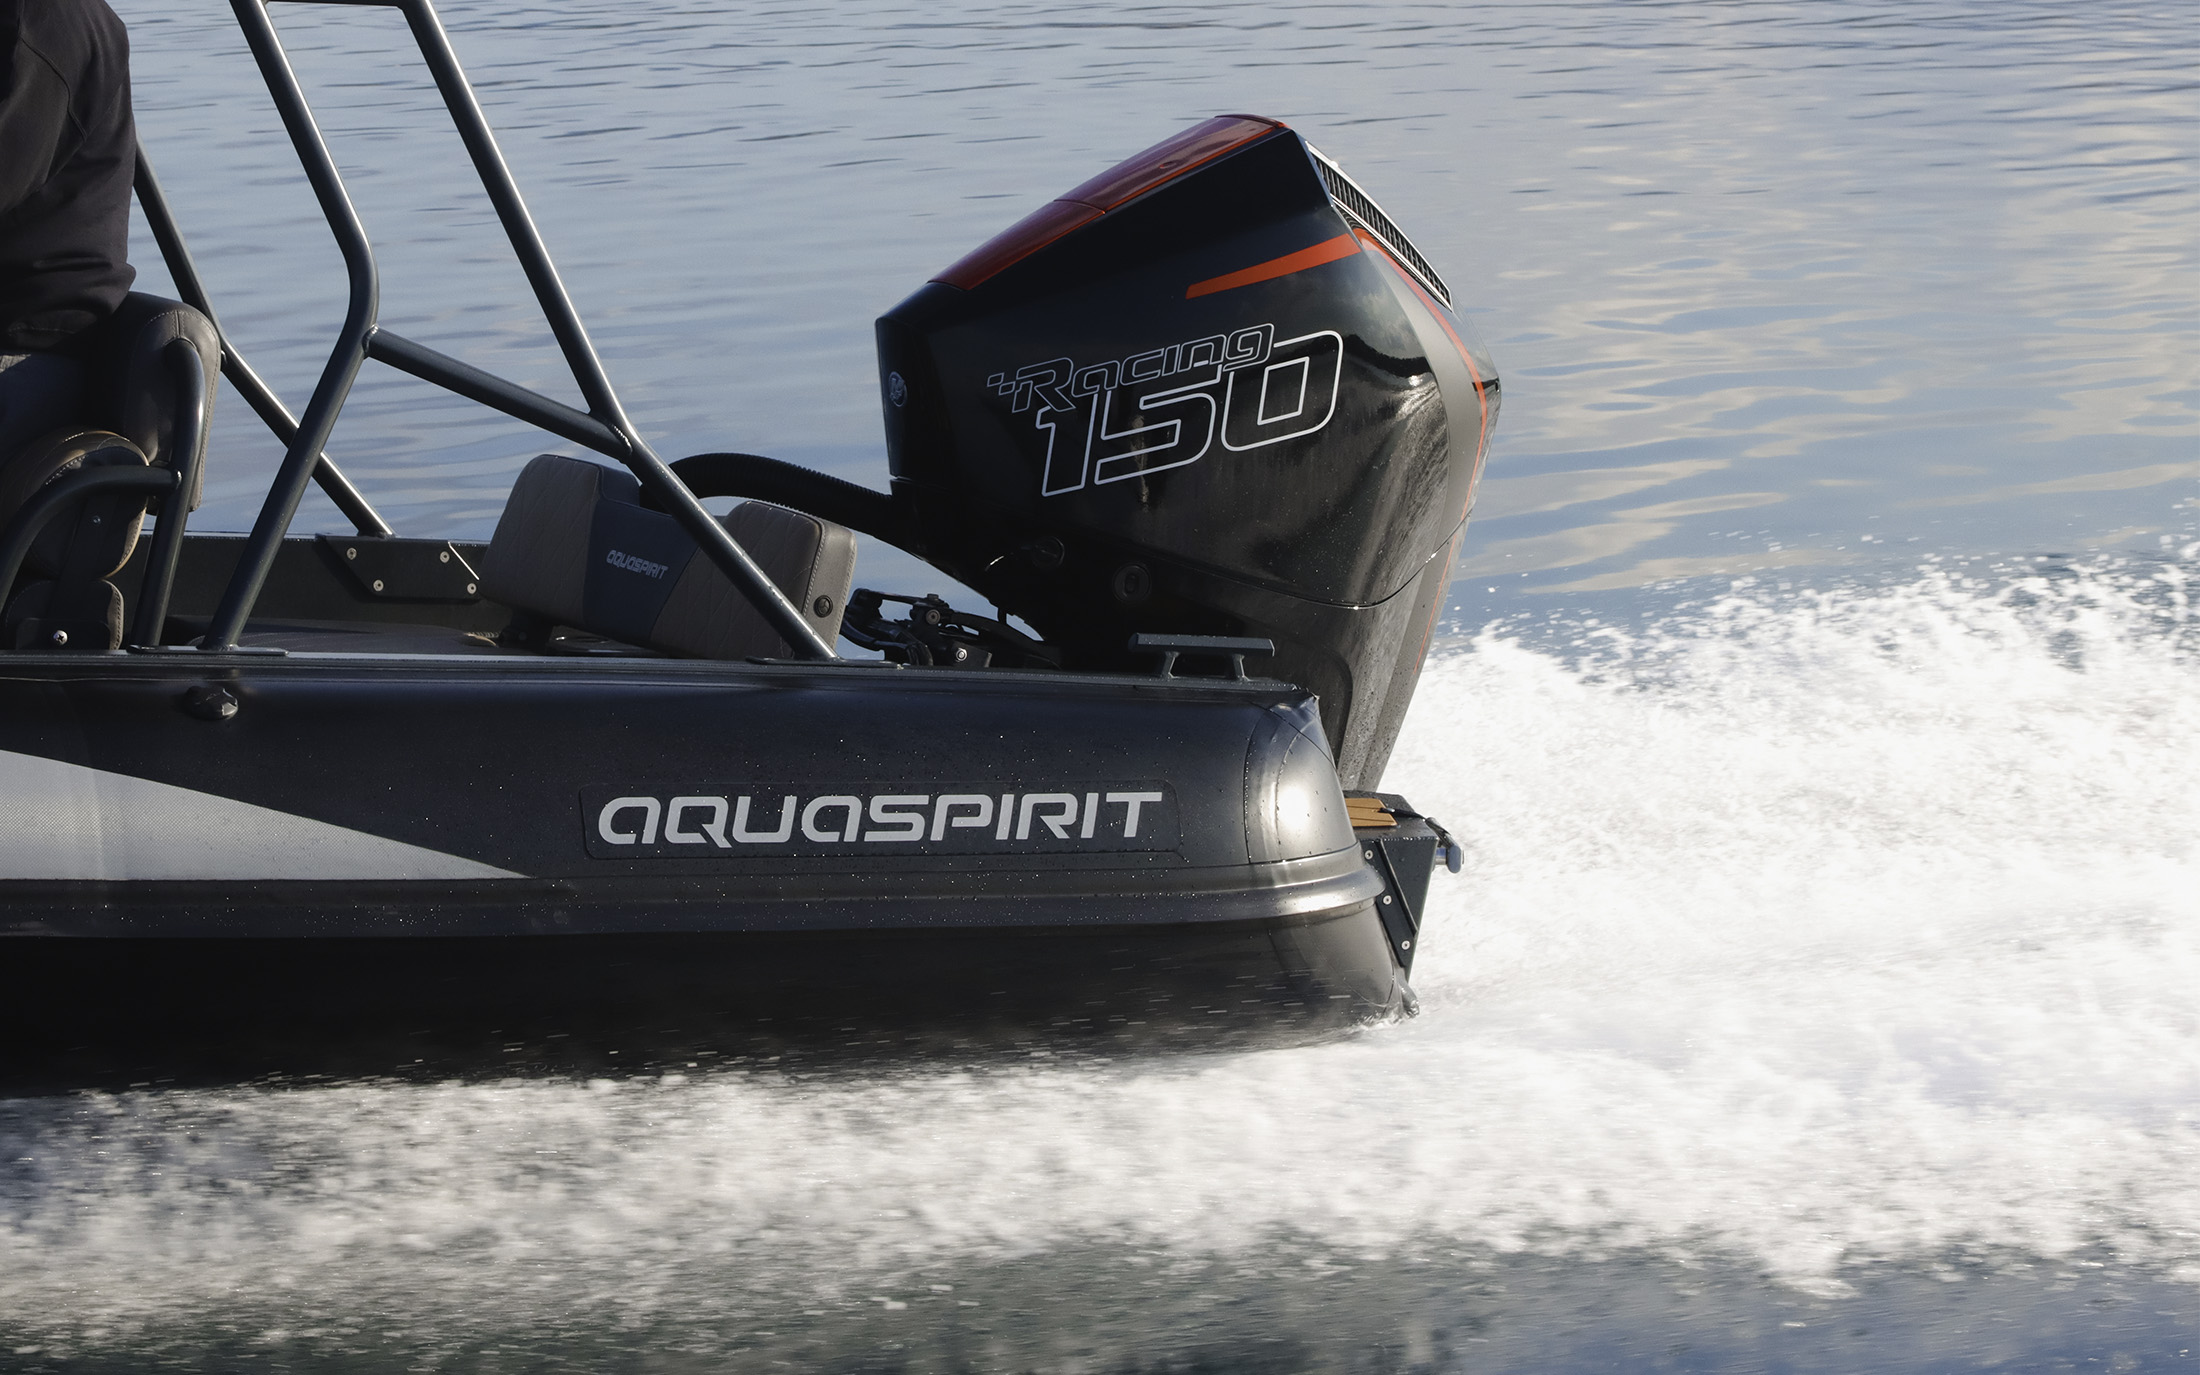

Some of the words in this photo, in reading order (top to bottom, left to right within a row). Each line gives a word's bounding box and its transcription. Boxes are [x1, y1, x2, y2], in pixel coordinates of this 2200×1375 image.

[1011, 323, 1274, 413] Racing
[1036, 330, 1344, 497] 150
[606, 549, 669, 580] AQUASPIRIT
[599, 792, 1163, 849] AQUASPIRIT
